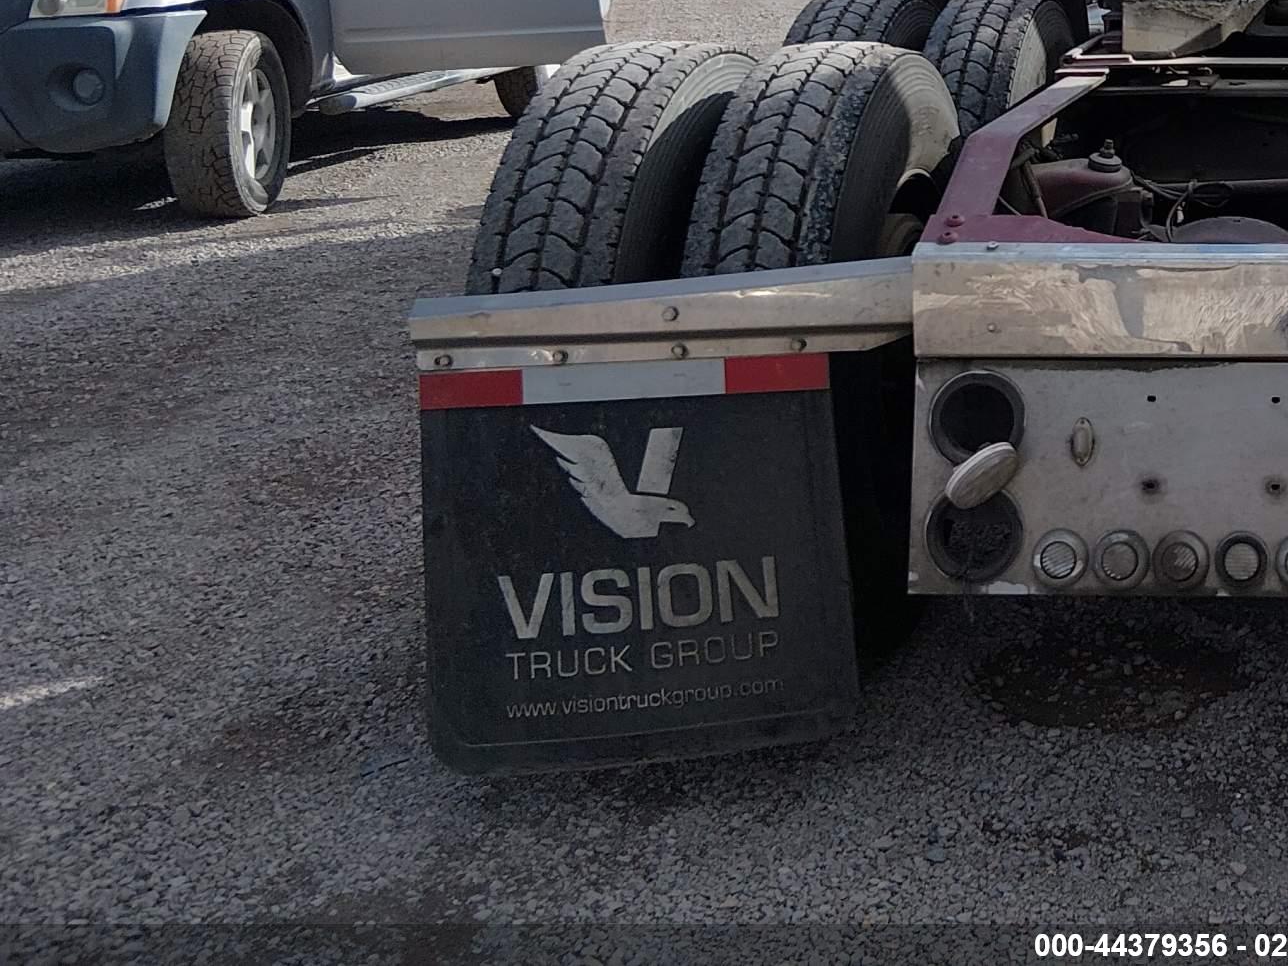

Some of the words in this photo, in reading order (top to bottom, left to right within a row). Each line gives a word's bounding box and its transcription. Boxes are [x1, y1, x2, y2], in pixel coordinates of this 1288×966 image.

[497, 556, 780, 639] VISION
[505, 644, 633, 679] TRUCK
[651, 631, 779, 669] GROUP
[506, 678, 784, 718] www.visiontruckgroup.com
